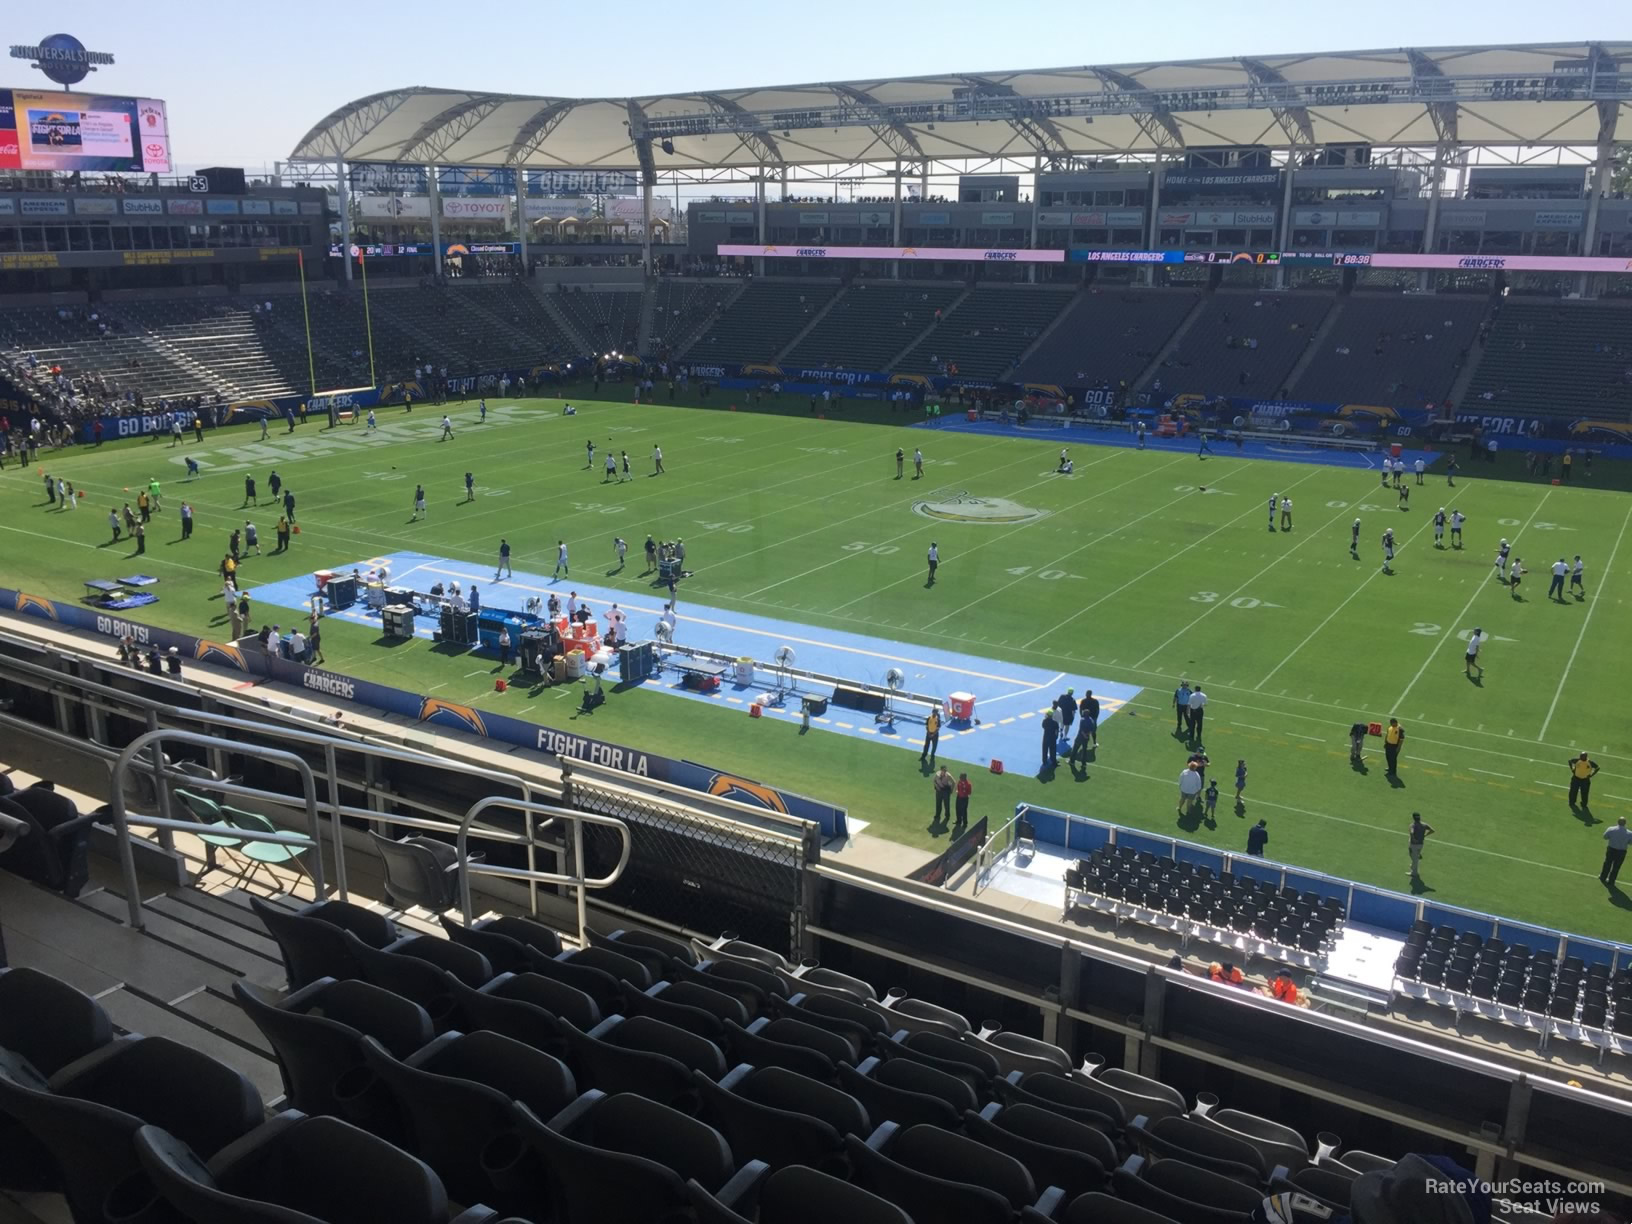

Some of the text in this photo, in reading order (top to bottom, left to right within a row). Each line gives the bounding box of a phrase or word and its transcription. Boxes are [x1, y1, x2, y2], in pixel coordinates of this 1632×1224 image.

[10, 45, 115, 64] UNIVERSAL STUDIOS
[192, 178, 206, 190] 25
[359, 171, 419, 188] CHARGERS
[1166, 176, 1187, 184] HOME
[1202, 176, 1213, 184] LOS
[1214, 175, 1242, 184] ANGELES
[1242, 174, 1277, 183] CHARGERS
[125, 202, 161, 212] StubHub
[1237, 214, 1273, 224] StubHub
[796, 249, 827, 257] CHARGERS
[984, 251, 1017, 260] CHARGERS
[1087, 252, 1165, 261] LOS ANGELES CHARGERS
[1208, 252, 1215, 262] 0
[1256, 253, 1264, 263] 0
[1458, 258, 1506, 268] CHARGERS
[1085, 390, 1103, 403] GO
[118, 418, 139, 436] GO
[1397, 426, 1411, 436] GO
[1482, 417, 1514, 433] FOR
[841, 541, 902, 556] 50
[1004, 565, 1068, 581] 40
[1188, 591, 1262, 609] 30
[97, 616, 149, 645] GO BOLTS!
[1408, 621, 1490, 643] 20
[303, 671, 355, 699] CHARGERS
[1369, 723, 1382, 734] 20
[537, 728, 648, 777] FIGHT FOR LA
